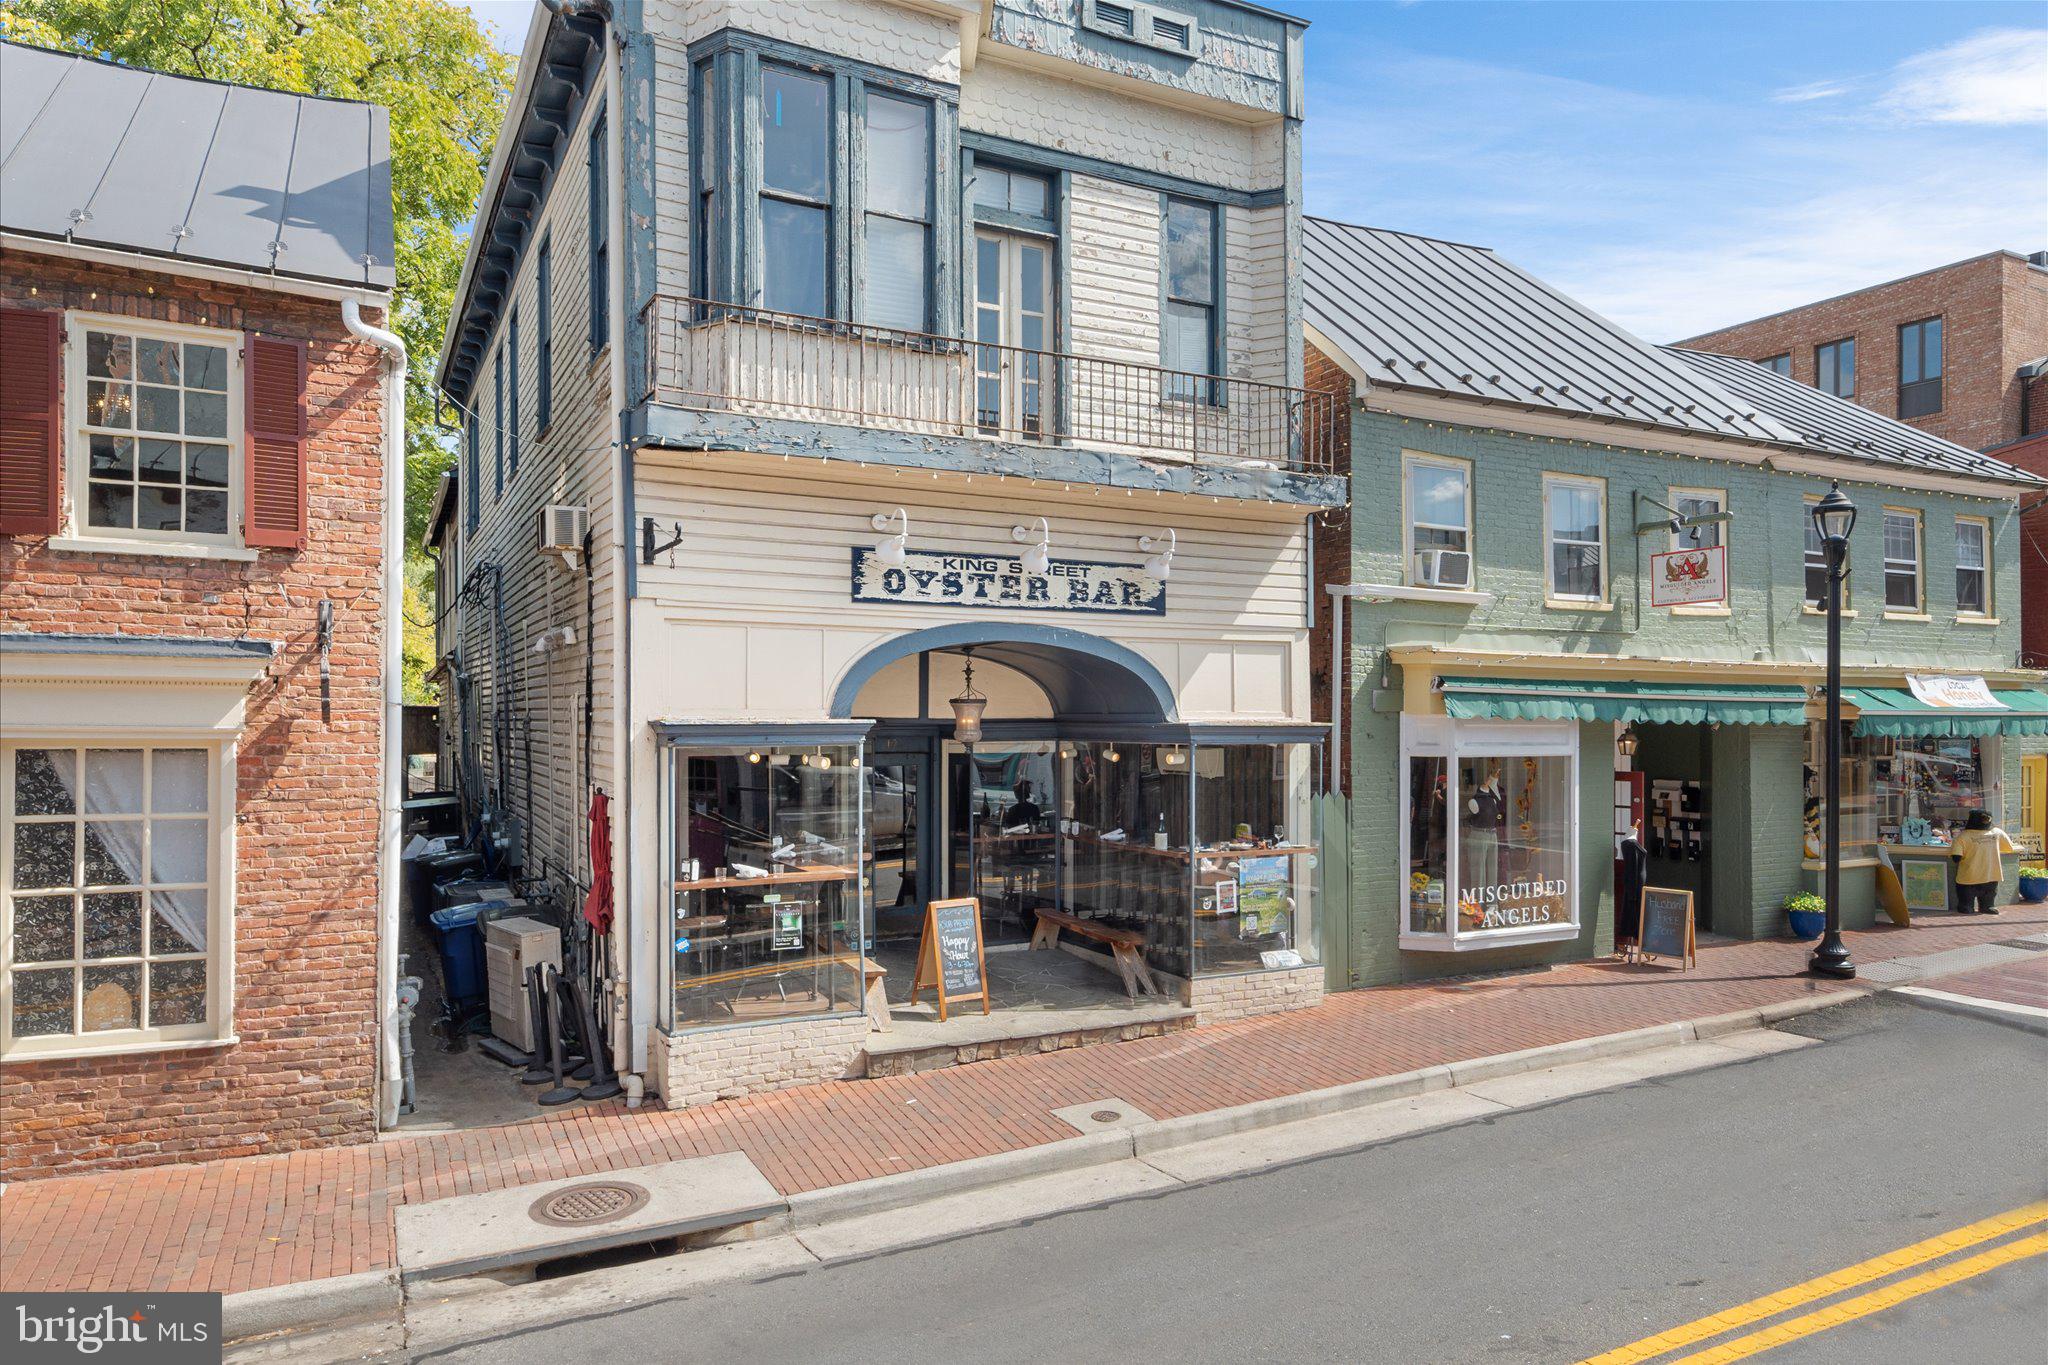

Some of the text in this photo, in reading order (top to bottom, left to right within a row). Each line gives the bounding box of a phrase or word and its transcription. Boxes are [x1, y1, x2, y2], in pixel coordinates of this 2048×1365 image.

[943, 557, 1092, 578] KING SEET
[881, 568, 1143, 606] OYSTER BAR
[1694, 578, 1717, 586] ANGELS
[1461, 879, 1567, 905] MISGUIDED
[1481, 905, 1550, 928] ANGELS
[942, 936, 970, 951] Happy
[949, 951, 969, 960] Hour
